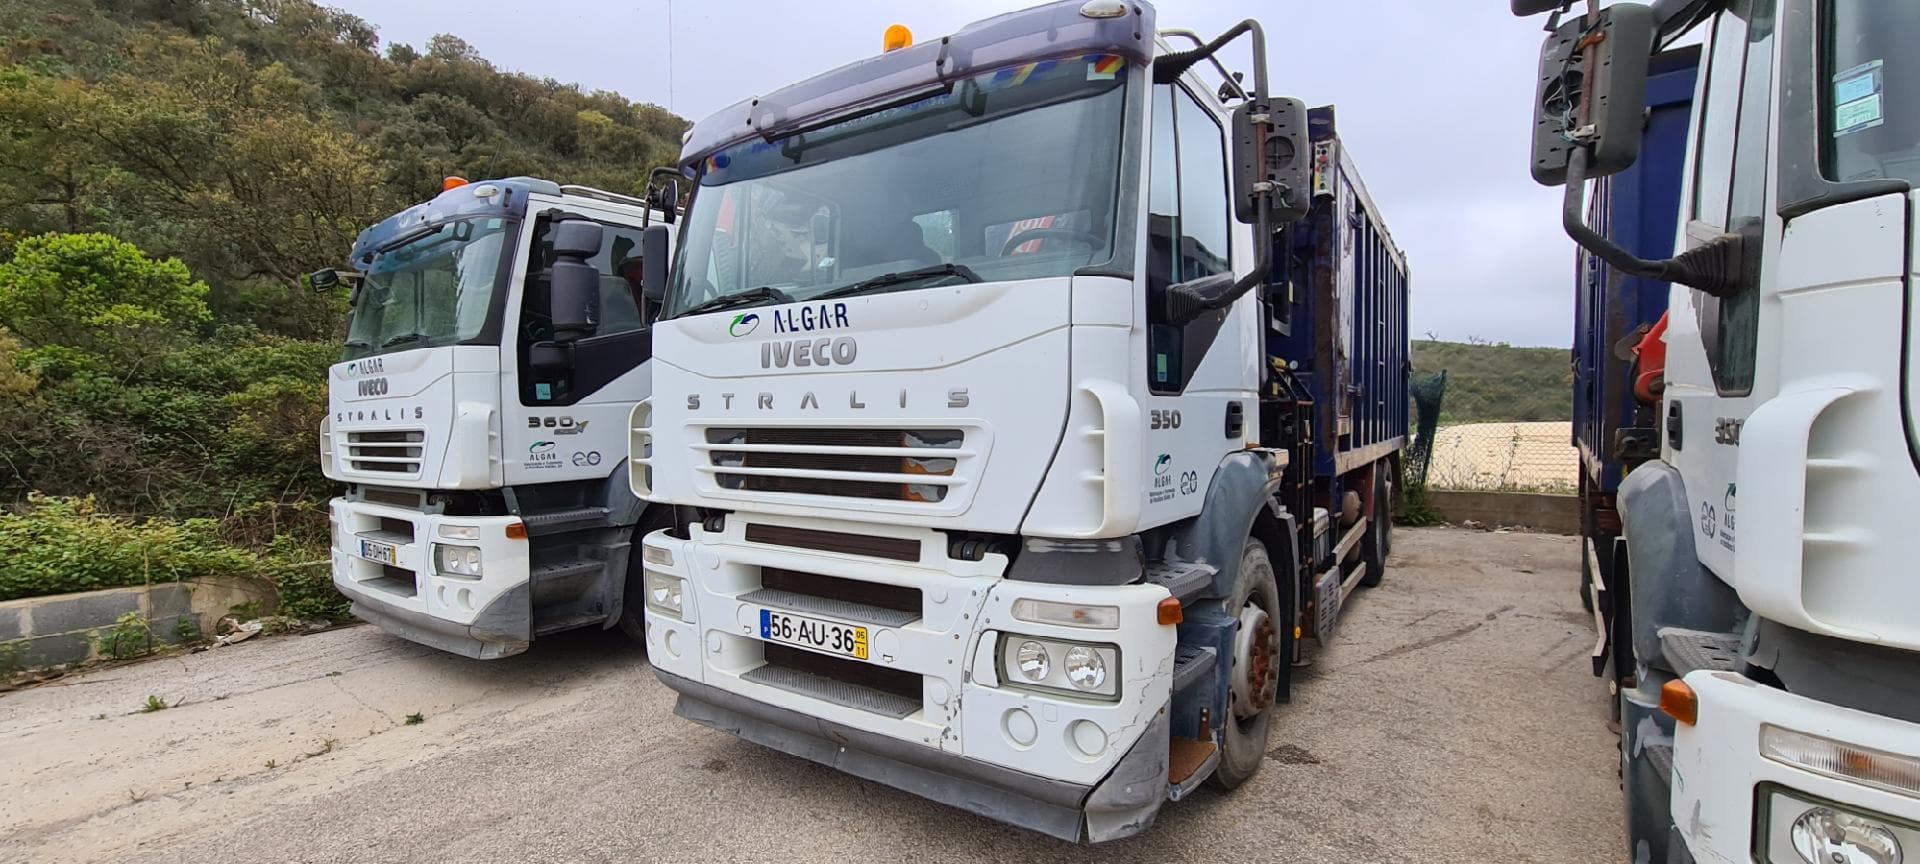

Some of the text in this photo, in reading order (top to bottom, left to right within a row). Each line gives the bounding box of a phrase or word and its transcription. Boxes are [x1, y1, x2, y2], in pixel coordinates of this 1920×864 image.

[774, 303, 849, 333] ALGAR
[760, 336, 857, 369] IVECO
[359, 358, 384, 375] ALGAR
[358, 377, 388, 397] IVECO
[686, 387, 970, 410] STRALIS
[337, 406, 423, 422] STRALIS
[528, 416, 574, 428] 360
[1151, 410, 1181, 429] 350
[529, 453, 556, 461] ALGAR
